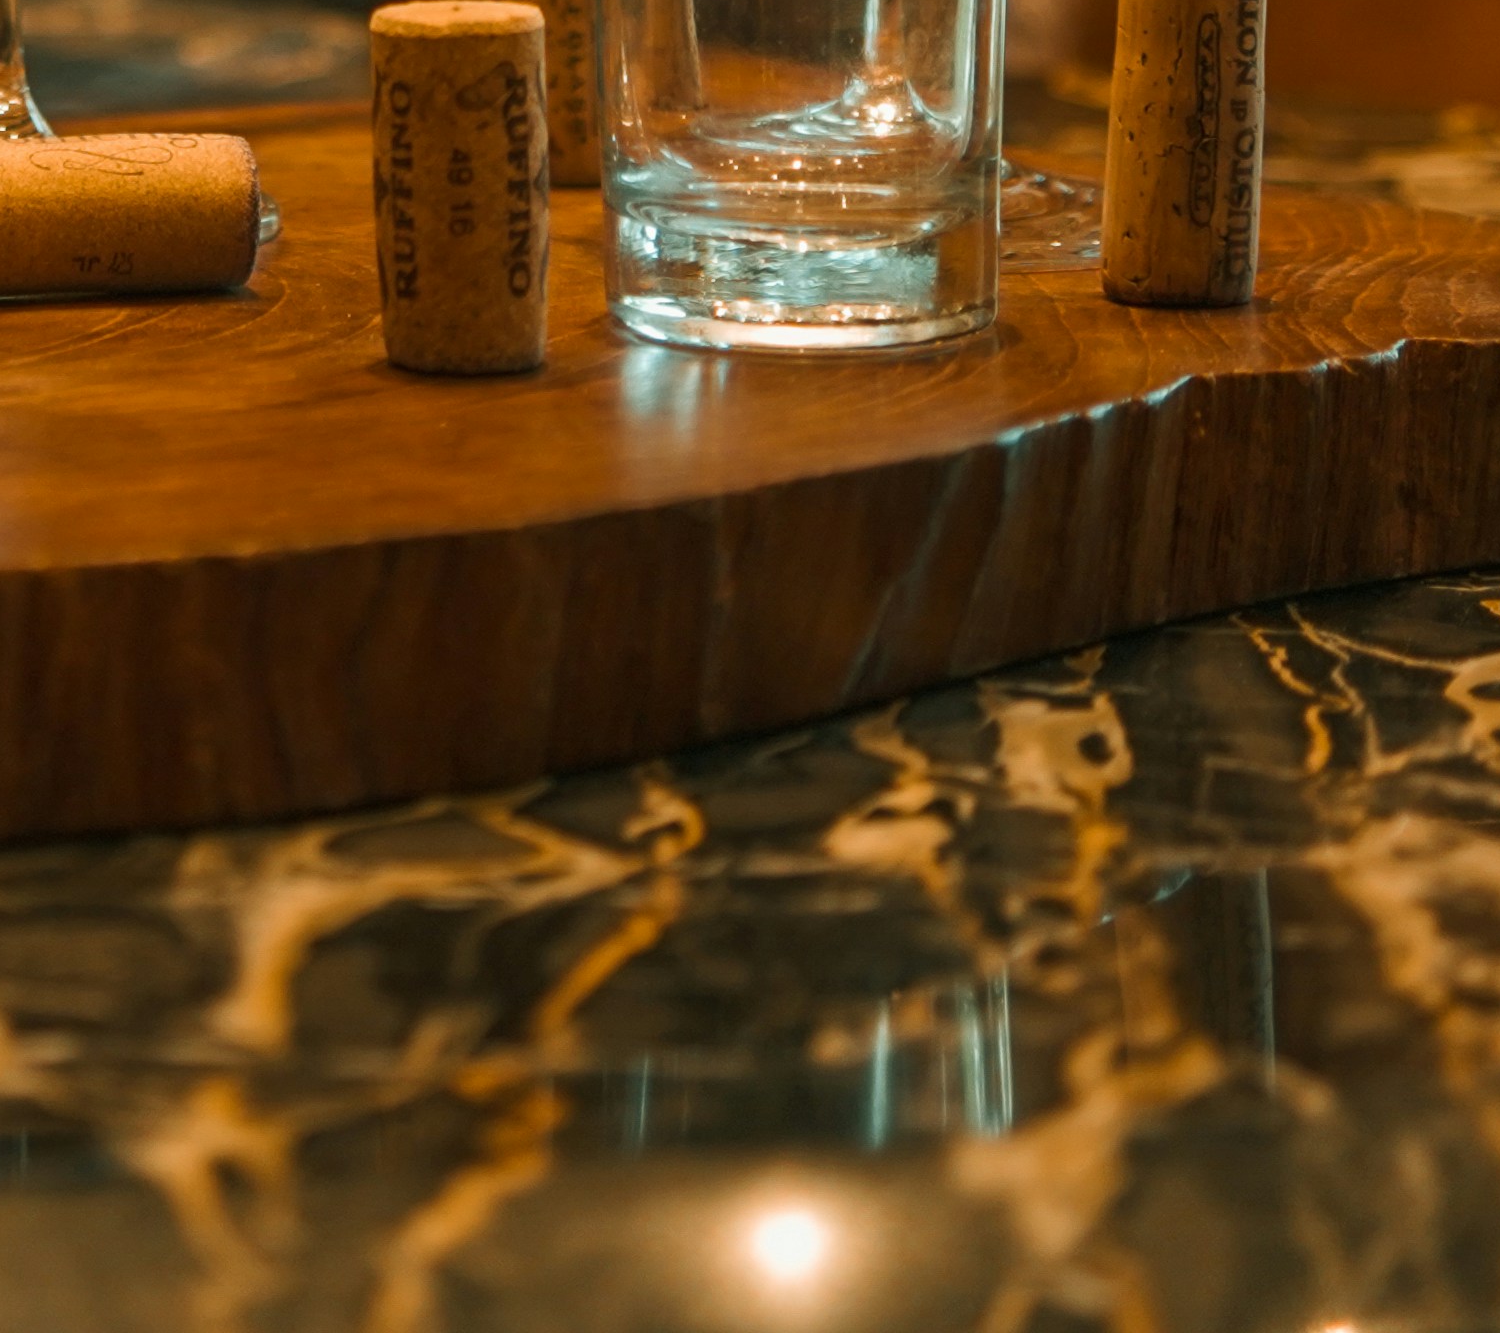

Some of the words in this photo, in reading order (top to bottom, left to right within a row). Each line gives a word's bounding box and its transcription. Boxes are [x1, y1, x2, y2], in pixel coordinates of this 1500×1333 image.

[390, 80, 418, 299] RUFFINO
[504, 74, 532, 300] RUFFINO
[1224, 130, 1257, 281] GIUSTO
